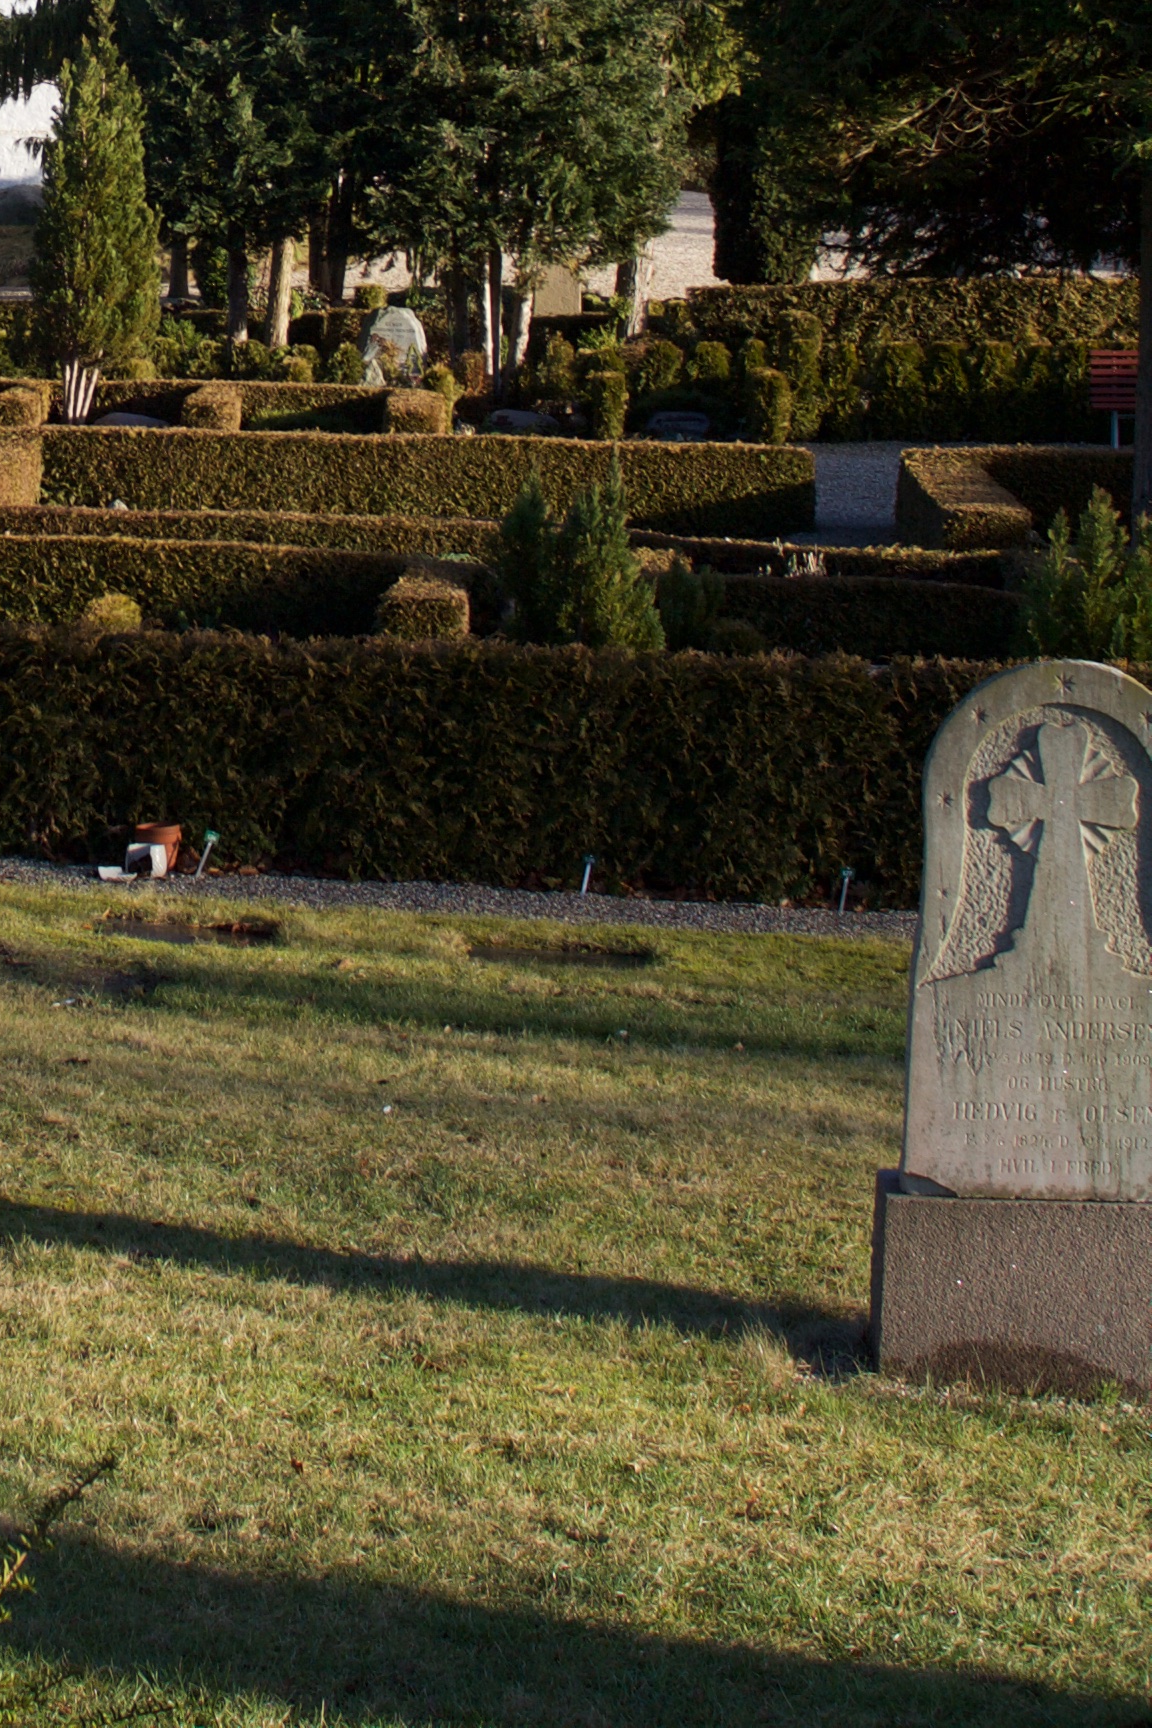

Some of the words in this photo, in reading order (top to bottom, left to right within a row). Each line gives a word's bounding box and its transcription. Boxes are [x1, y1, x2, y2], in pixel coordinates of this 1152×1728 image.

[1038, 994, 1085, 1009] OVER
[955, 1019, 1024, 1039] NIELS
[1006, 1076, 1029, 1090] OG
[1038, 1076, 1108, 1092] HUSTRU
[952, 1101, 1037, 1122] HEDVIG
[1065, 1160, 1112, 1175] FRED
